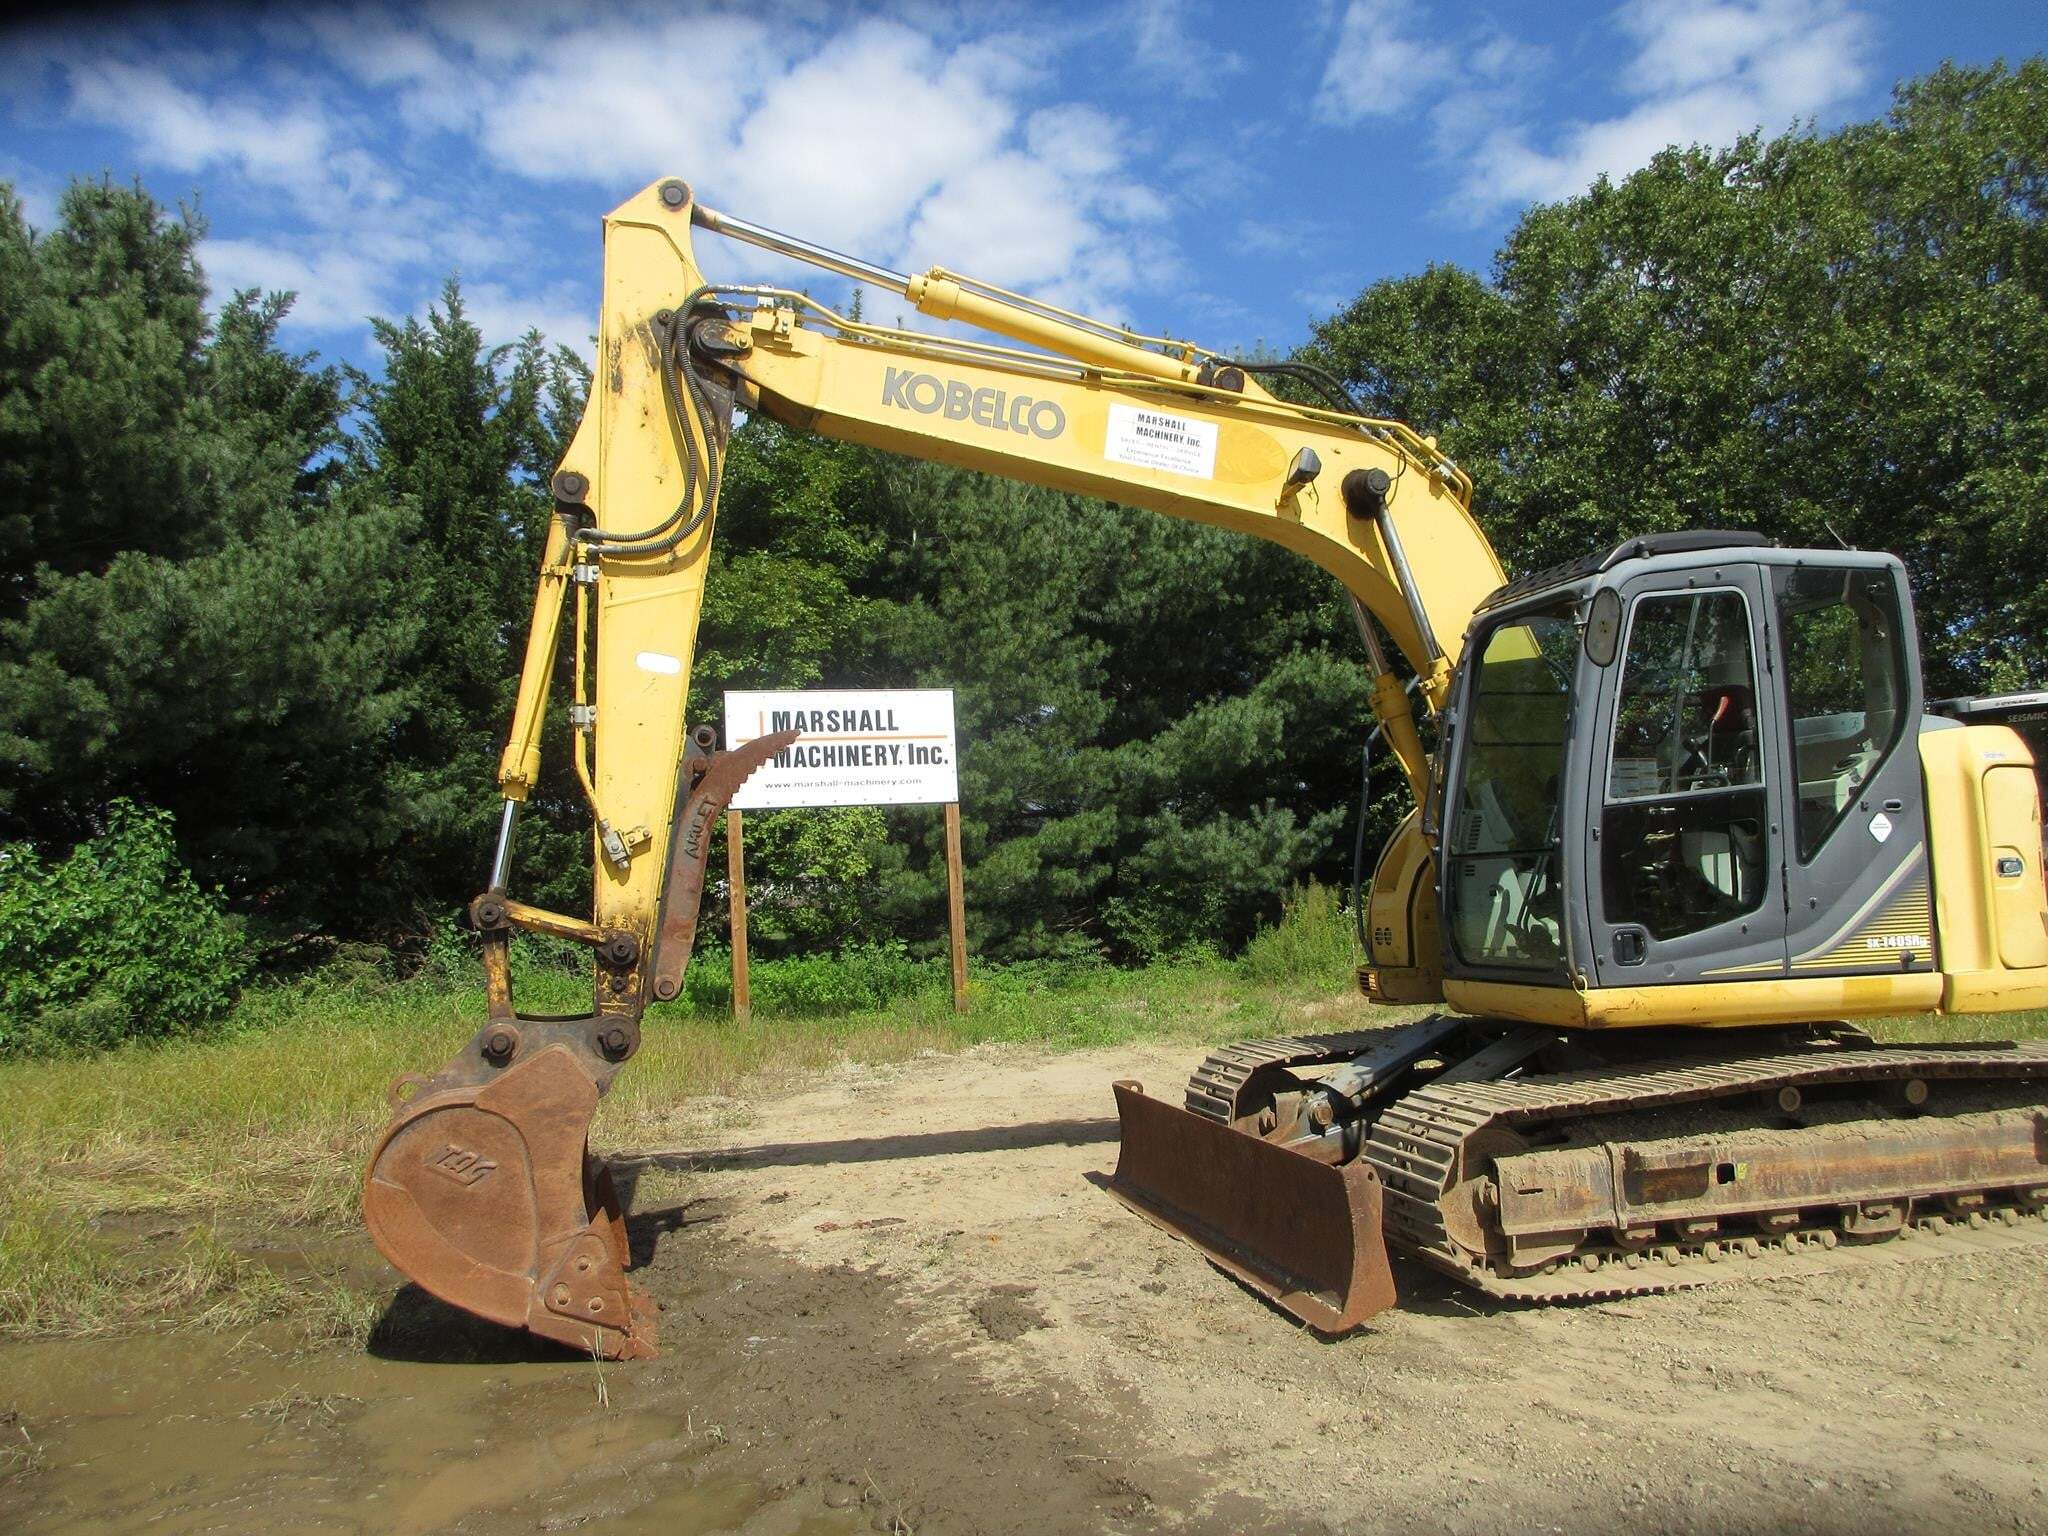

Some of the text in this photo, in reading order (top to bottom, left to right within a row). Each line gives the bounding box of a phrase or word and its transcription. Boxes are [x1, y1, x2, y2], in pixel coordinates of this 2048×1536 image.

[882, 366, 1066, 440] KOBELCO
[1137, 413, 1187, 431] MARSHALL
[772, 709, 899, 733] MARSHALL
[2008, 711, 2048, 723] SEISMIC
[908, 743, 948, 765] Inc.
[765, 777, 922, 789] www.marshall-machinery.com
